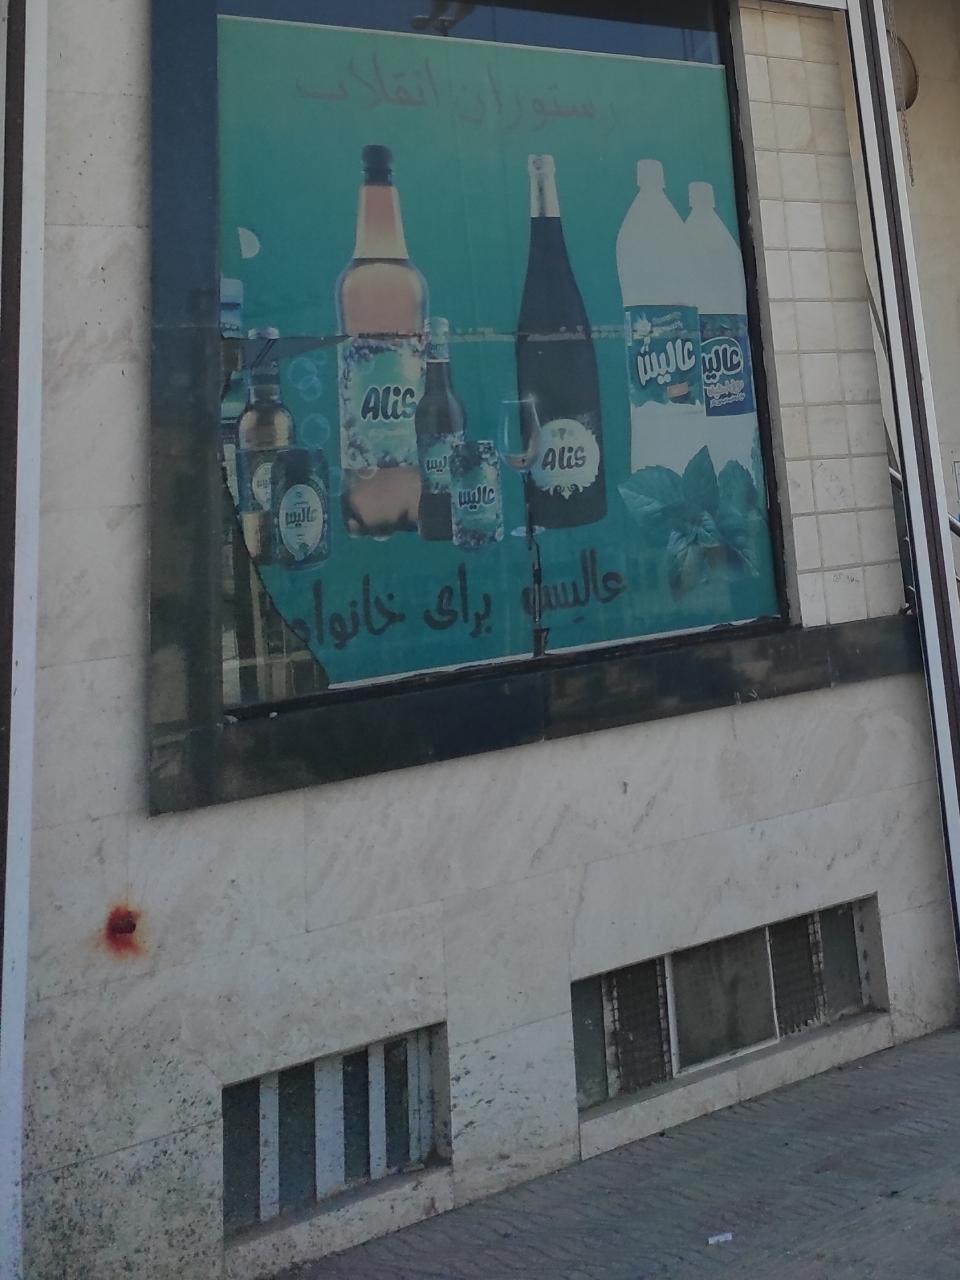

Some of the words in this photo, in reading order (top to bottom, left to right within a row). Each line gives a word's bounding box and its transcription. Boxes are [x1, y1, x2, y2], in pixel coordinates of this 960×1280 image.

[360, 384, 417, 421] Alis
[541, 446, 587, 472] Alis
[458, 485, 497, 510] عالیس
[424, 562, 492, 638] برای
